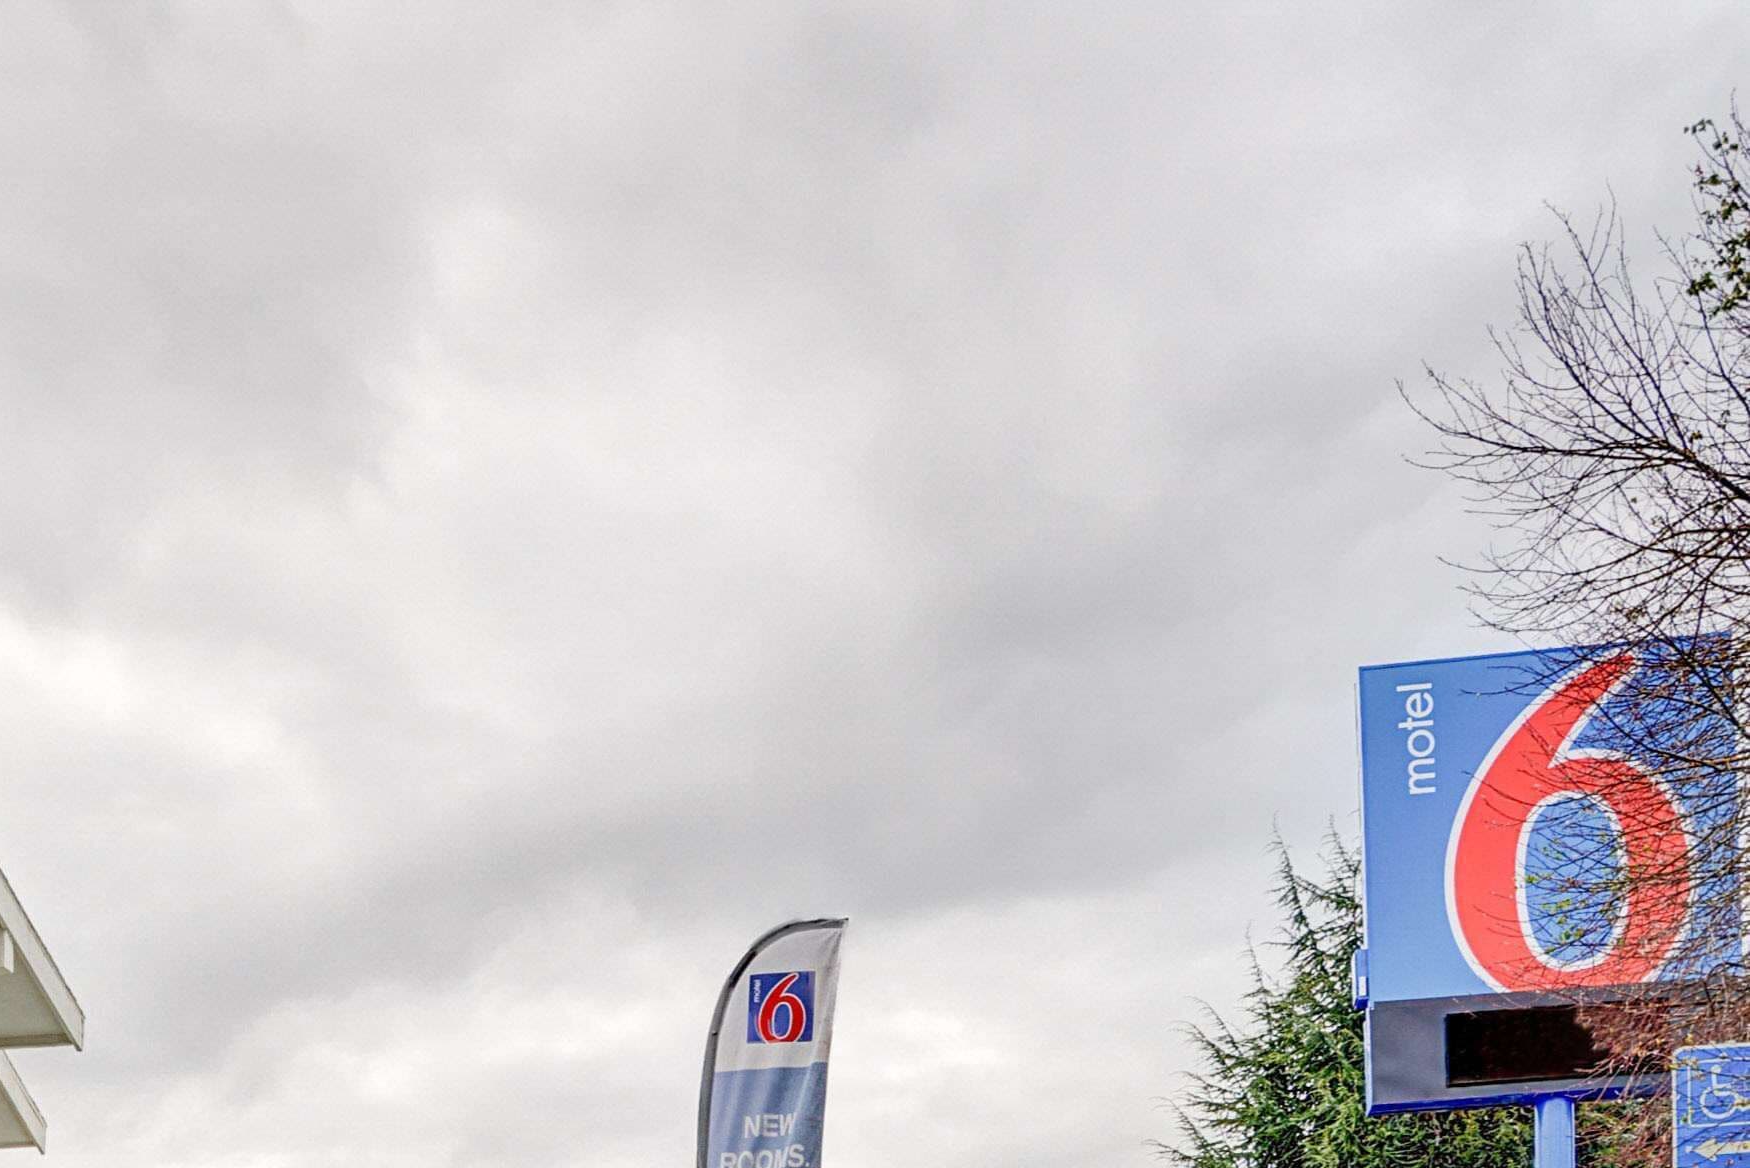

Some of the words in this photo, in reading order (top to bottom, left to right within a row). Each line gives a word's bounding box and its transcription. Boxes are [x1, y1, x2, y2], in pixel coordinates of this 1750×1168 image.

[1396, 682, 1436, 796] motel
[1444, 647, 1699, 994] 6
[753, 979, 763, 1003] motel
[757, 972, 807, 1044] 6
[743, 1112, 797, 1139] NEW
